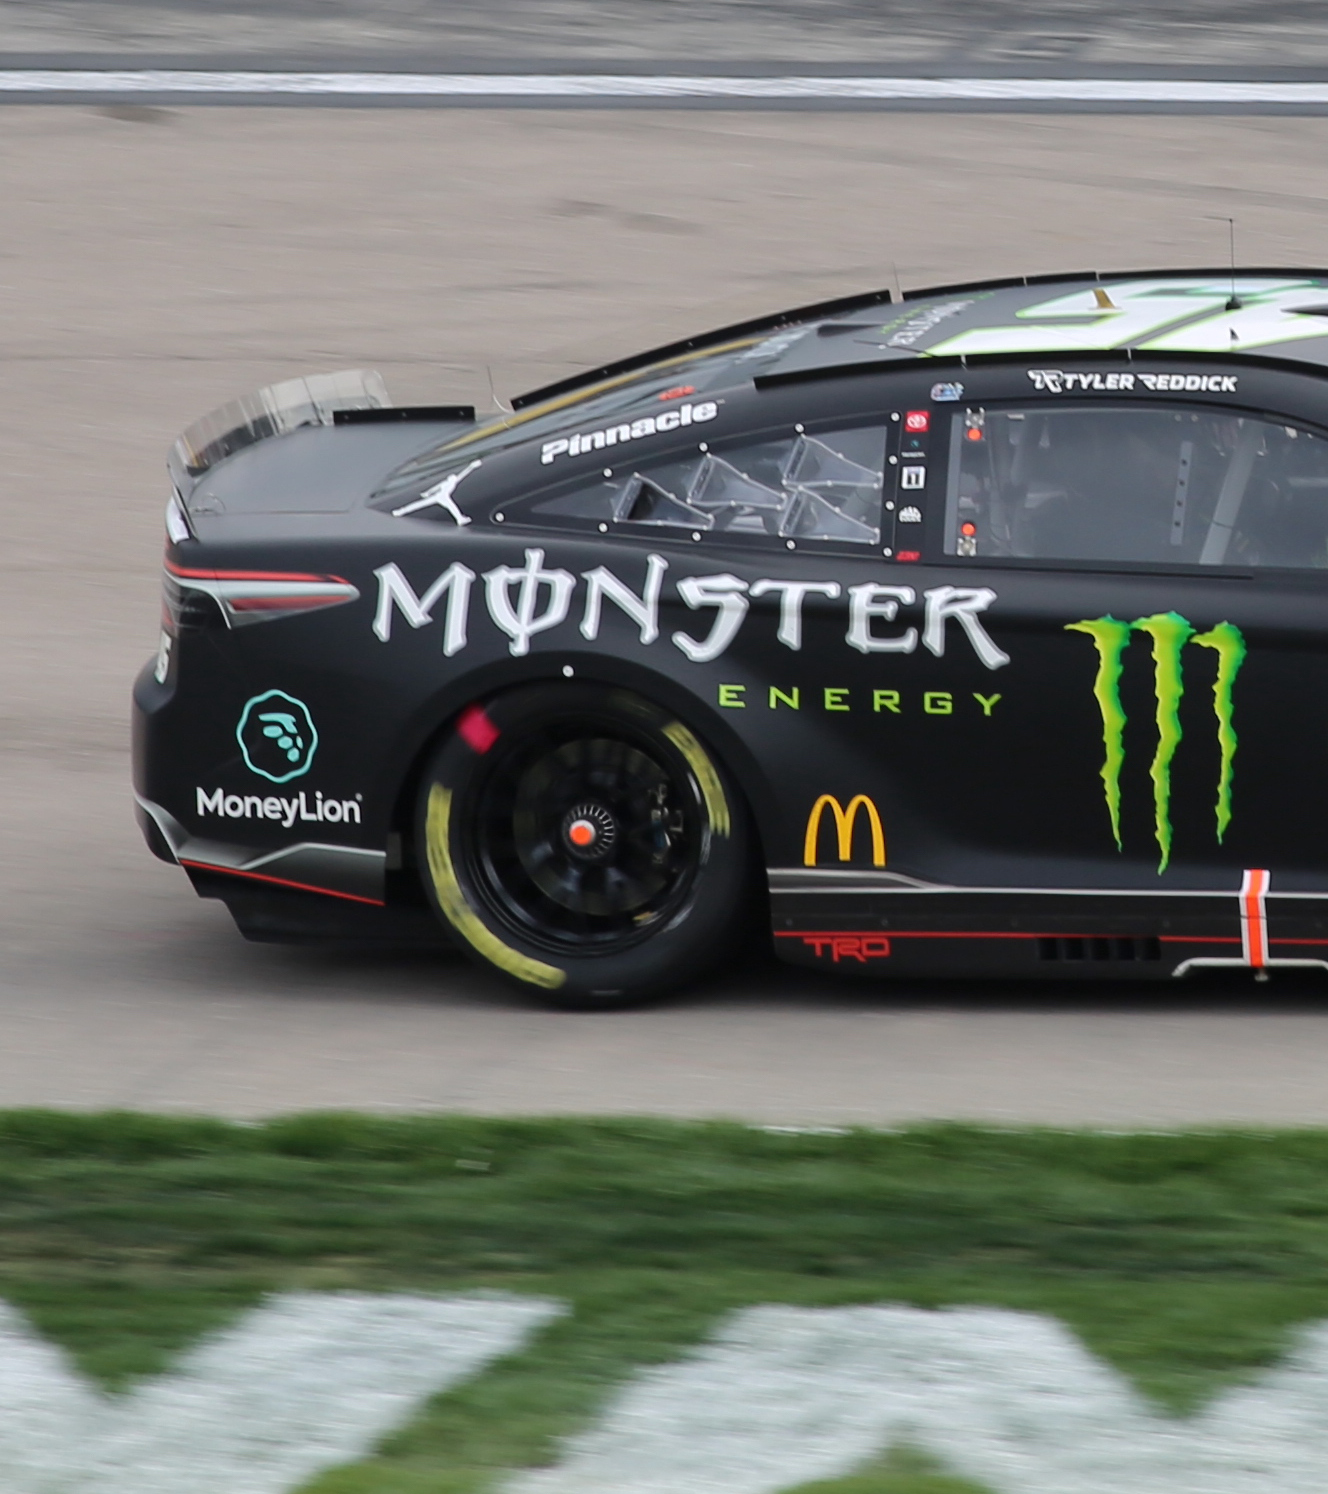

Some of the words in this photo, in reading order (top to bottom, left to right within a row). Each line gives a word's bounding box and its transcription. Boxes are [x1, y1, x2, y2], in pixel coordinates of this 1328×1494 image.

[1063, 373, 1135, 391] TYLER
[1136, 373, 1239, 392] REDDICK
[540, 401, 719, 466] Pinnacle
[718, 683, 1002, 717] ENERGY
[196, 786, 361, 829] MoneyLion
